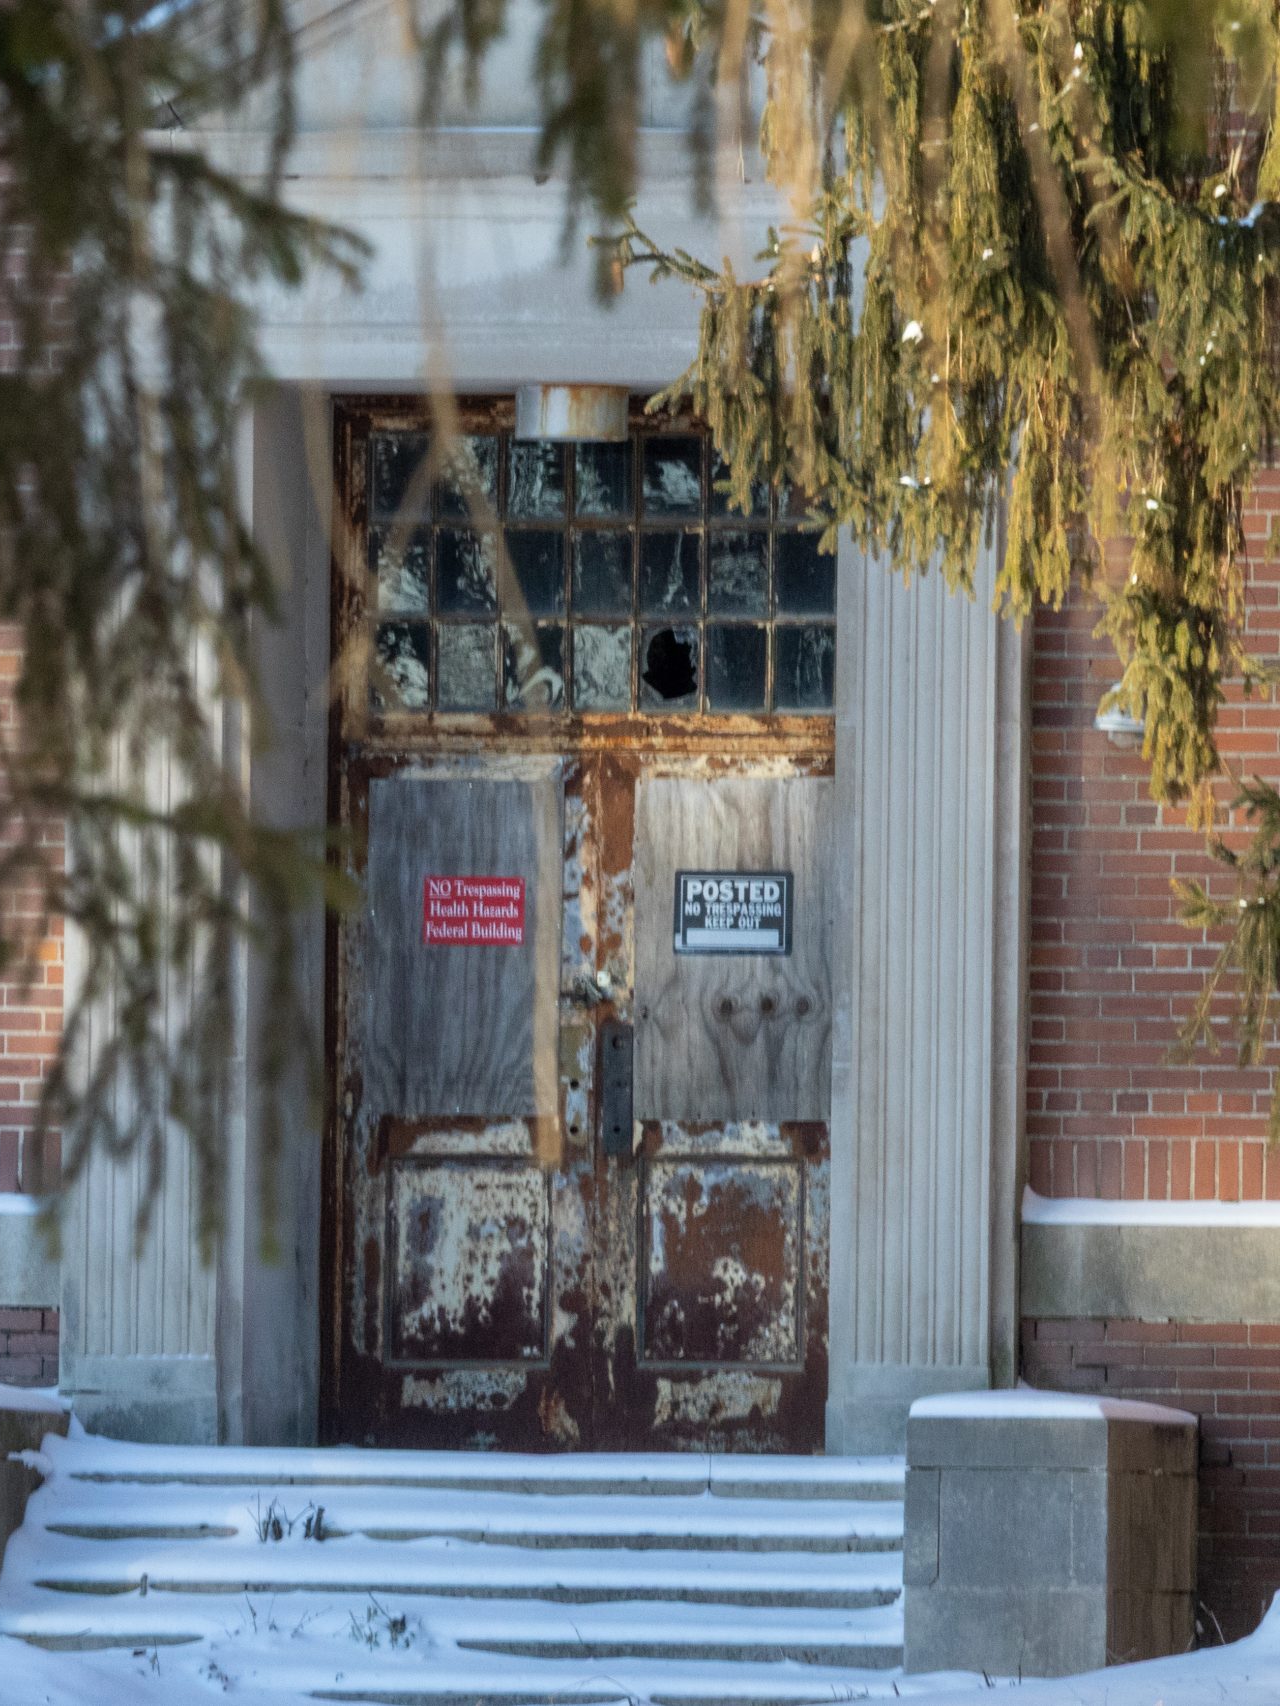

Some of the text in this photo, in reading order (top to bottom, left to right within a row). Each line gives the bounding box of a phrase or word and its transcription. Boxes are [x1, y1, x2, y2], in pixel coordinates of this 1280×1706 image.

[429, 880, 520, 900] NO Trespassing
[687, 880, 780, 902] POSTED
[431, 900, 519, 918] Health Hazards
[685, 902, 781, 917] NO TRESPASSING
[426, 921, 522, 941] Federal Building
[705, 916, 761, 930] KEEP OUT
